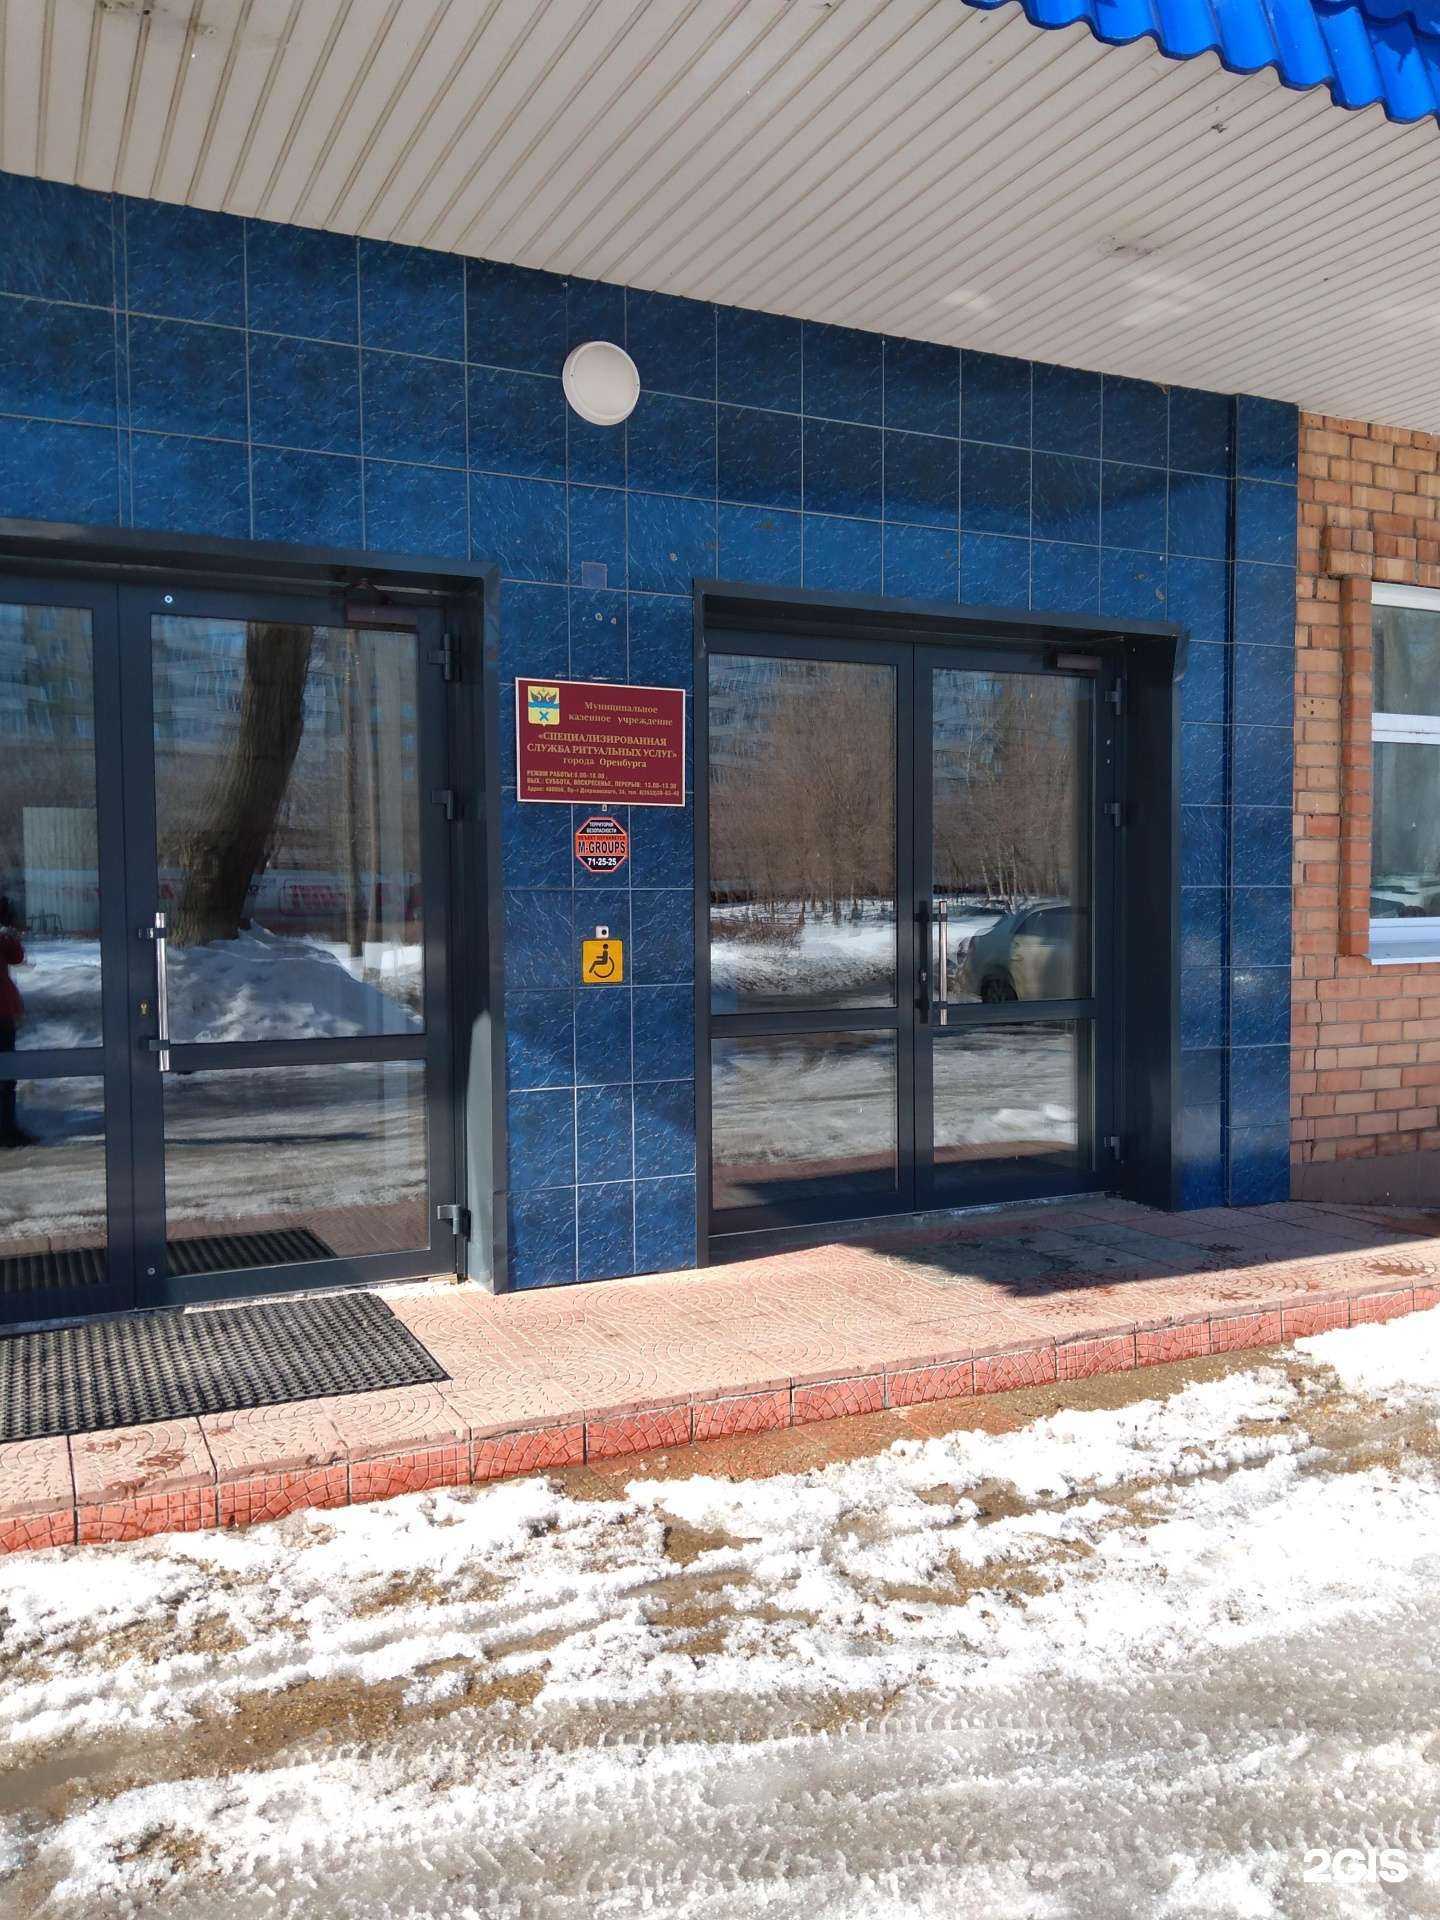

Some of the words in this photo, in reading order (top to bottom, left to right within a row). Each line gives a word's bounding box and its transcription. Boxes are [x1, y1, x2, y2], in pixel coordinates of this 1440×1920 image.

[584, 701, 659, 714] Муниципальное
[568, 714, 612, 724] казенное
[618, 716, 674, 728] учреждение
[538, 731, 667, 746] «СПЕЦИАЛИЗИРОВАННАЯ
[527, 743, 571, 754] СЛУЖБА
[572, 745, 642, 757] РИТУАЛЬНЫХ
[643, 748, 678, 759] УСЛУГ»
[563, 757, 595, 766] города
[599, 757, 648, 769] Оренбурга
[578, 841, 626, 854] M-GROUPS
[587, 857, 617, 866] 71-25-25
